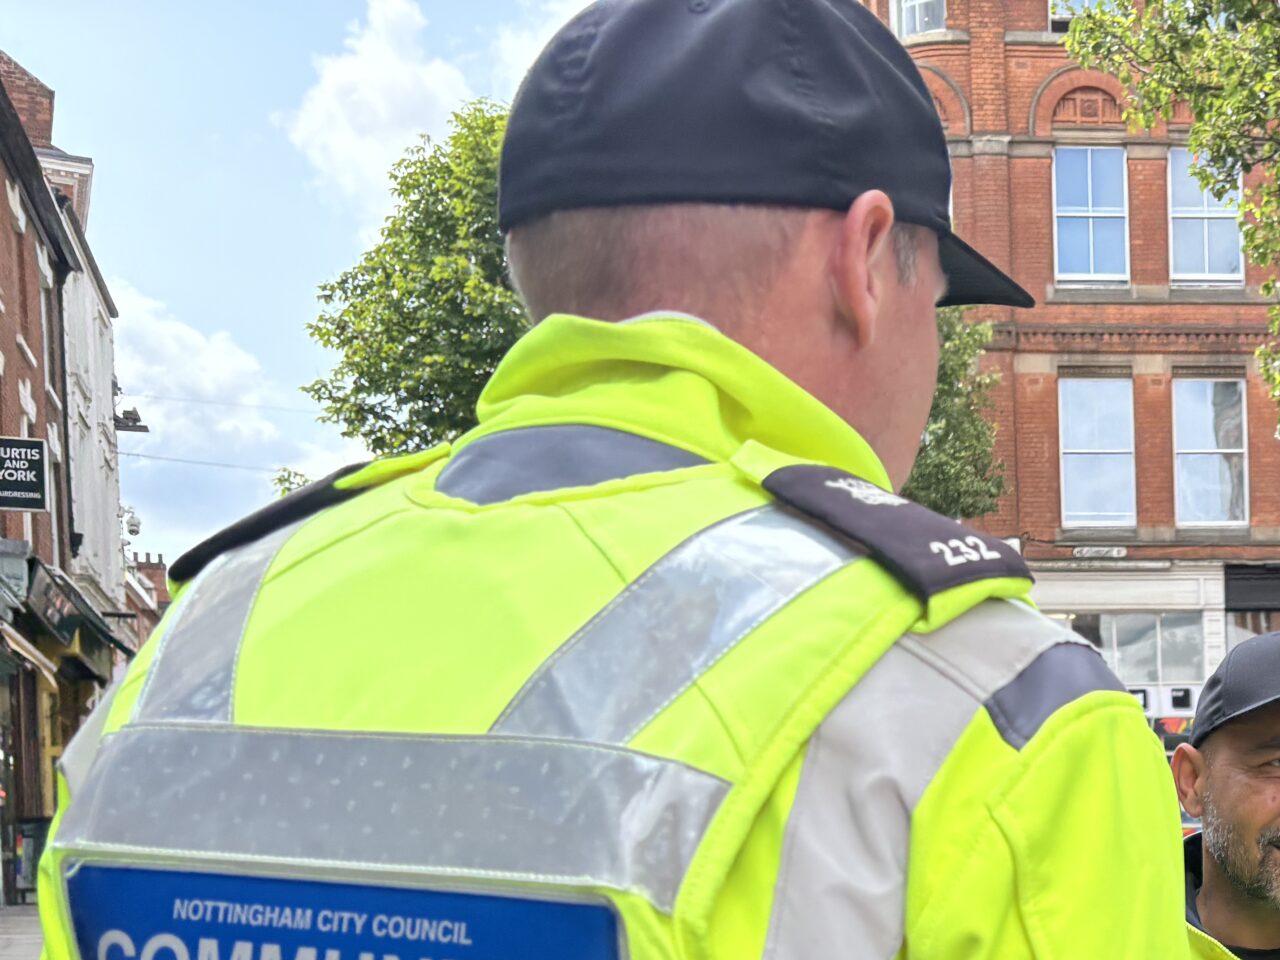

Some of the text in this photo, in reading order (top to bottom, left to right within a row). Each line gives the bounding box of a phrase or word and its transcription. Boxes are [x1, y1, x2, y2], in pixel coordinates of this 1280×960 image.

[4, 459, 29, 469] AND
[929, 536, 1001, 566] 232
[173, 898, 473, 945] NOTTINGHAM CITY COUNCIL
